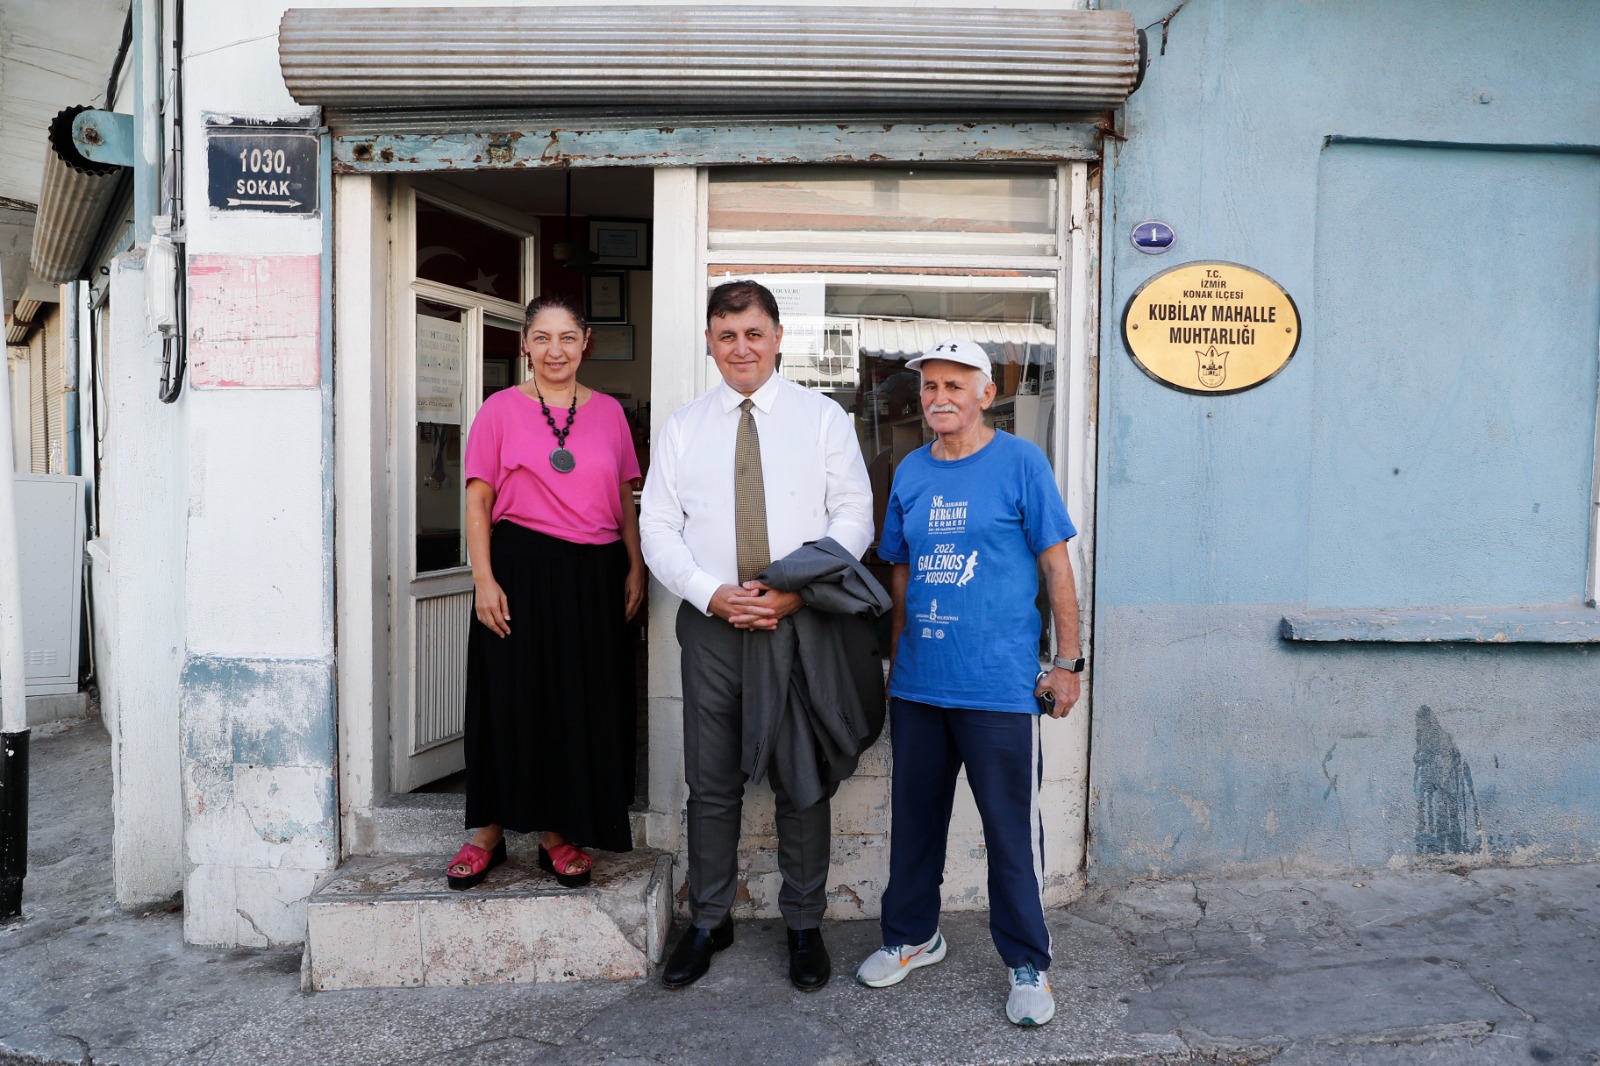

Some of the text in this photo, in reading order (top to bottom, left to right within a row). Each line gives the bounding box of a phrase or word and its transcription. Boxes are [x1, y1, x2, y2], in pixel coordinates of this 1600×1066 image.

[240, 148, 291, 174] 1030.
[236, 179, 290, 195] SOKAK
[1151, 227, 1158, 242] 1
[1206, 270, 1222, 279] T.C.
[1201, 280, 1227, 289] İZMİR
[1183, 290, 1244, 301] KONAK İLÇESİ
[1149, 301, 1276, 323] KUBİLAY MAHALLE
[1169, 325, 1256, 345] MUHTARLIĞI
[932, 495, 944, 508] 86.
[929, 507, 967, 521] BERGAMA
[934, 543, 955, 554] 2022
[918, 554, 965, 571] GALENOS
[925, 571, 958, 586] KOŞUSU
